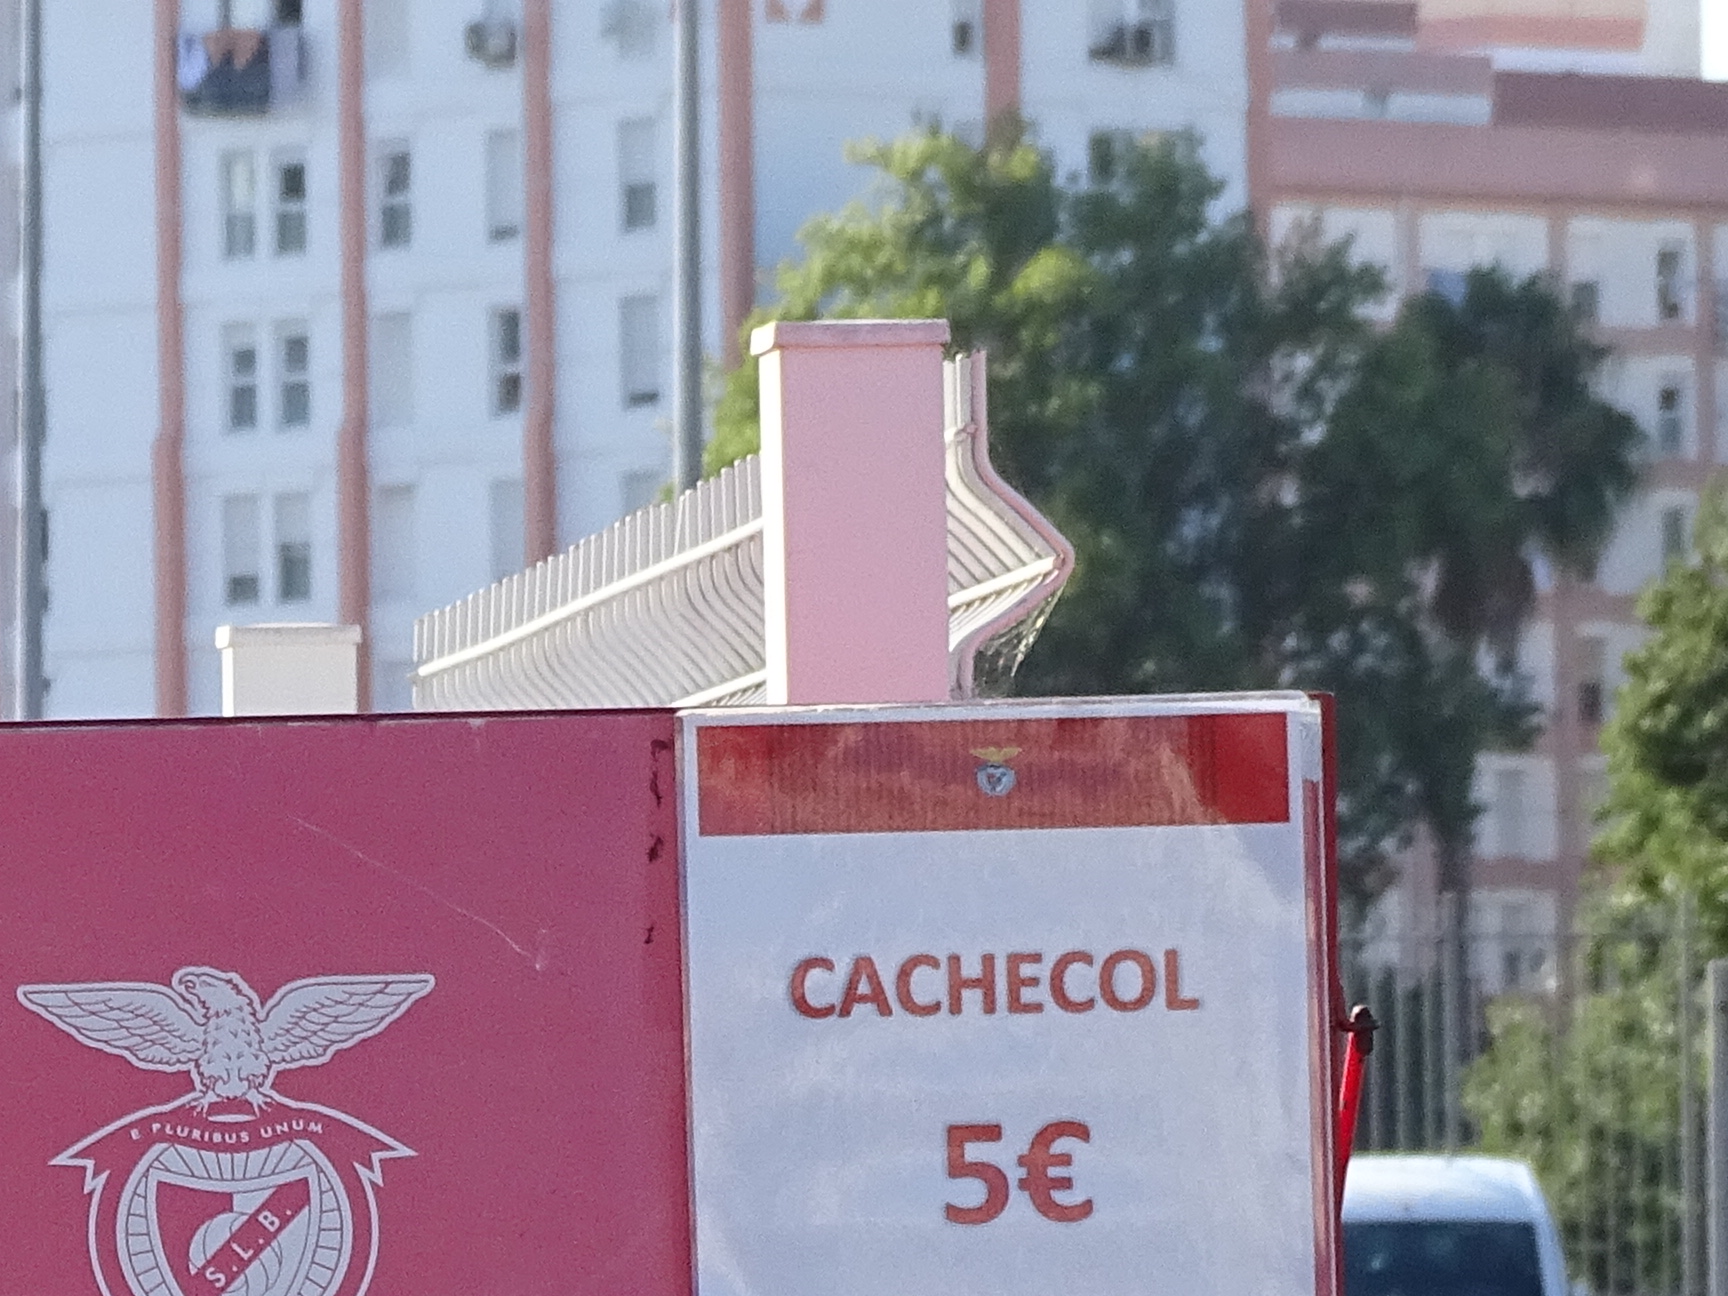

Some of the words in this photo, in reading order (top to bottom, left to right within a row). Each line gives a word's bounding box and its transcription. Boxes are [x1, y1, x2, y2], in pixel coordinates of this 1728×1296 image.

[789, 946, 1200, 1021] CACHECOL
[151, 1122, 250, 1144] PLURIBUS
[260, 1118, 324, 1138] UNUM
[943, 1120, 1095, 1226] 5€
